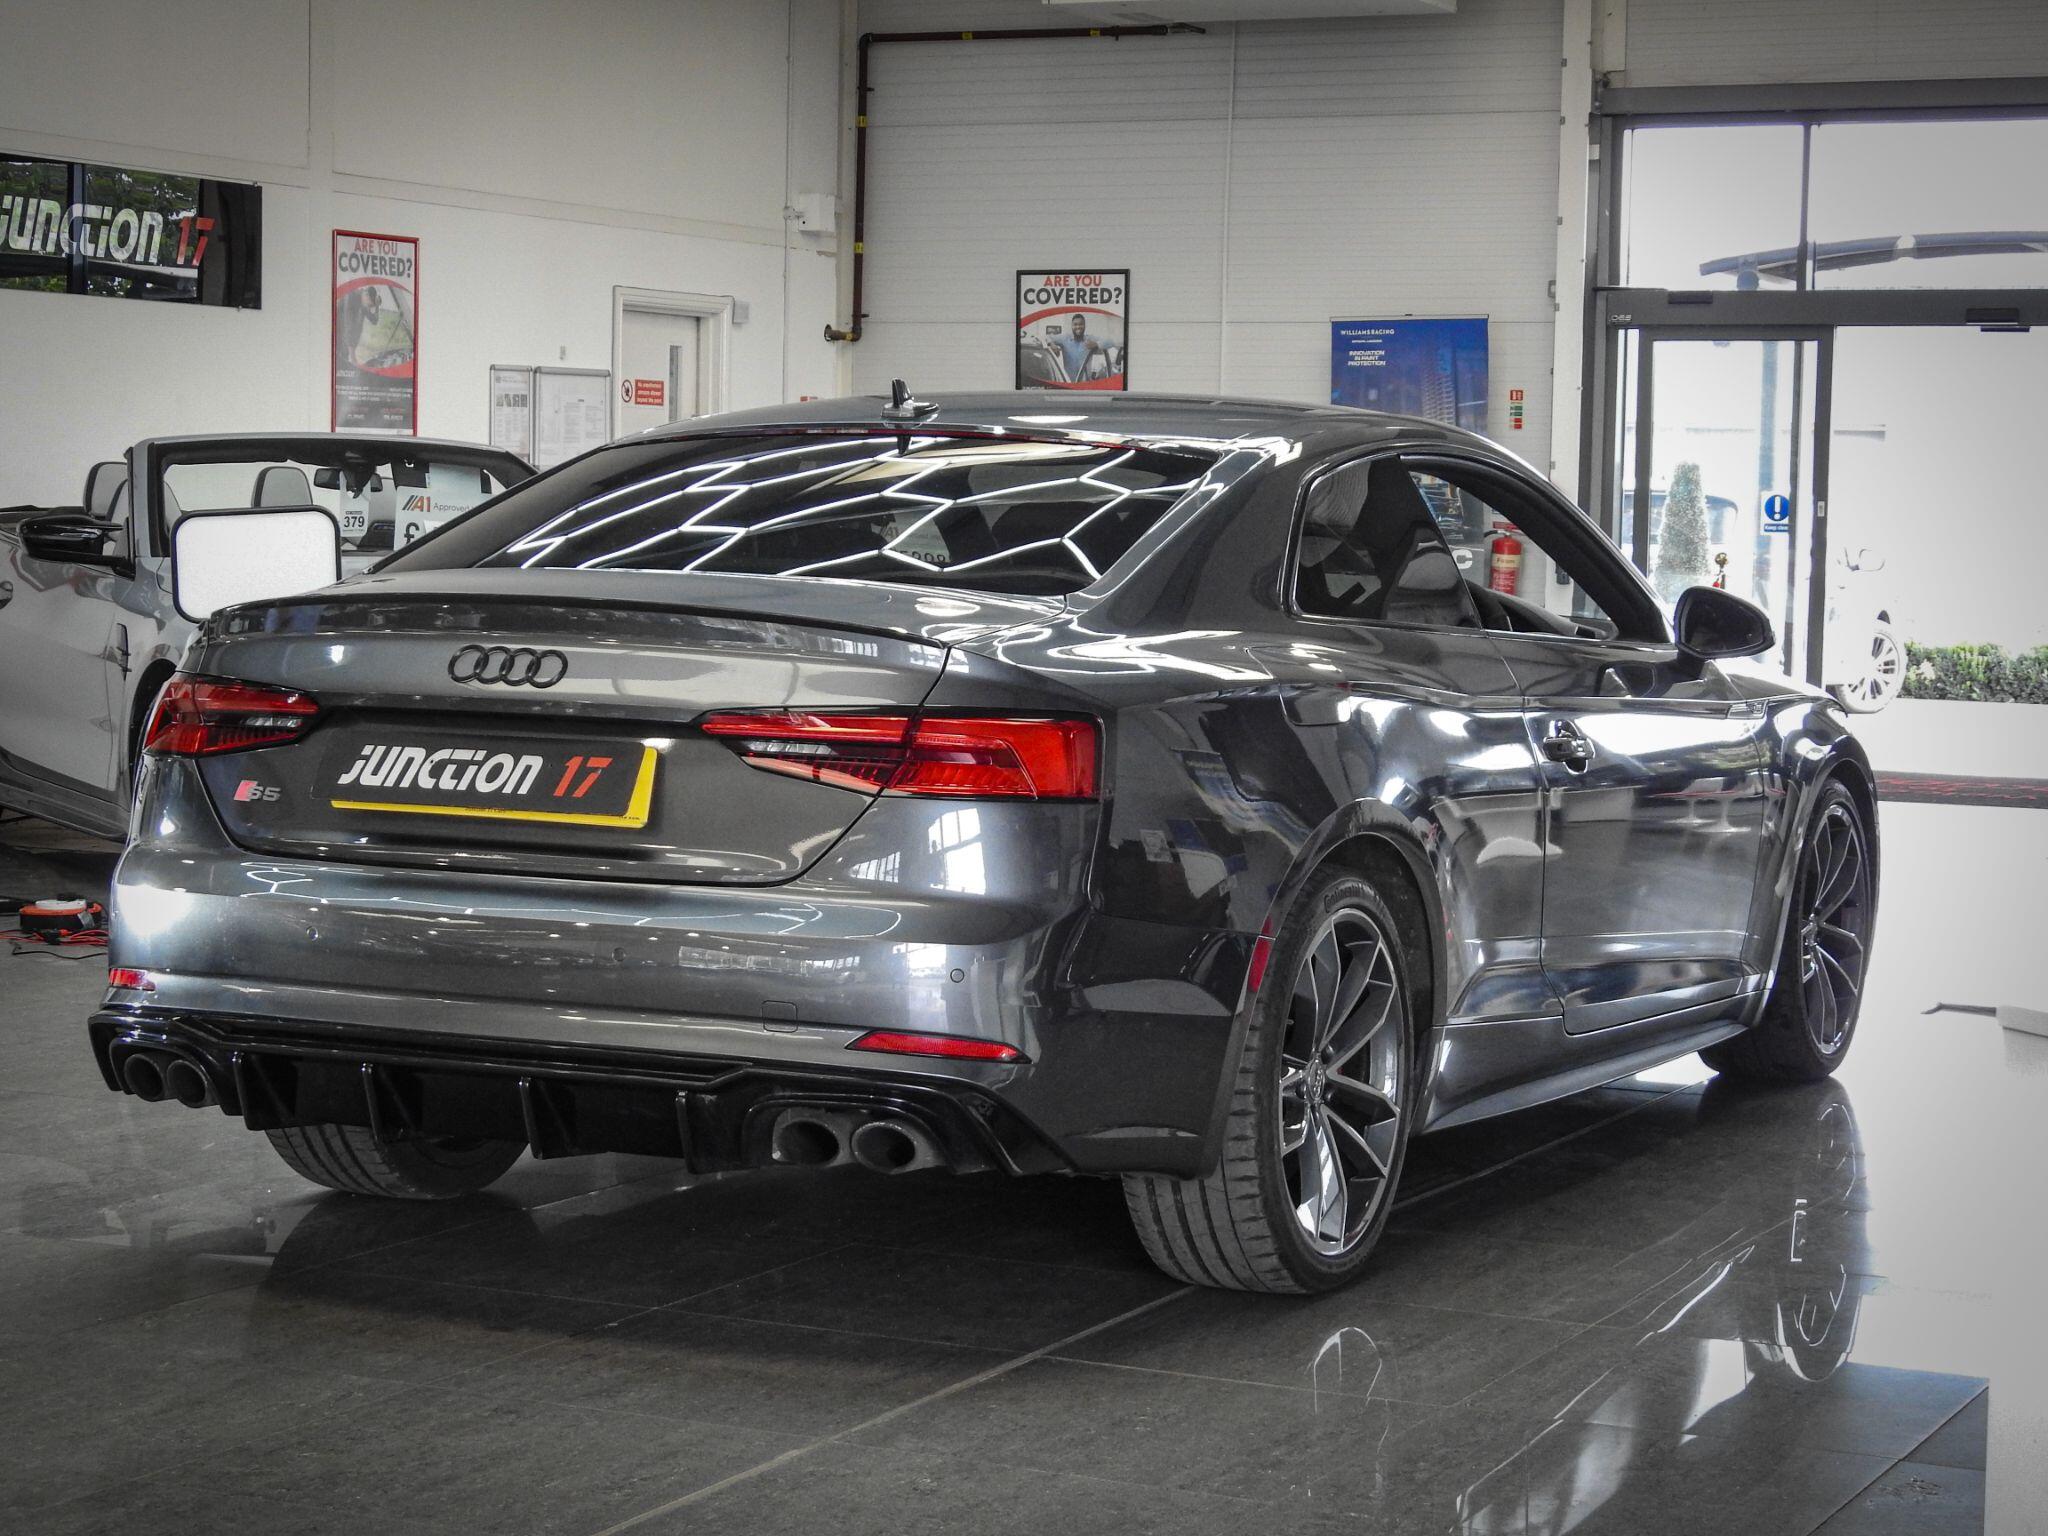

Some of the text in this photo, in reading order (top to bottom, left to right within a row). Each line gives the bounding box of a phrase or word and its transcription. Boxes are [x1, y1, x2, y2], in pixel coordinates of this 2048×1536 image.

[176, 216, 215, 267] 17
[354, 239, 398, 257] ARE YOU
[338, 251, 413, 279] COVERED?
[1043, 274, 1102, 287] ARE YOU
[1023, 287, 1123, 305] COVERED?
[343, 515, 365, 528] 379
[337, 744, 613, 798] JUNCTION 17
